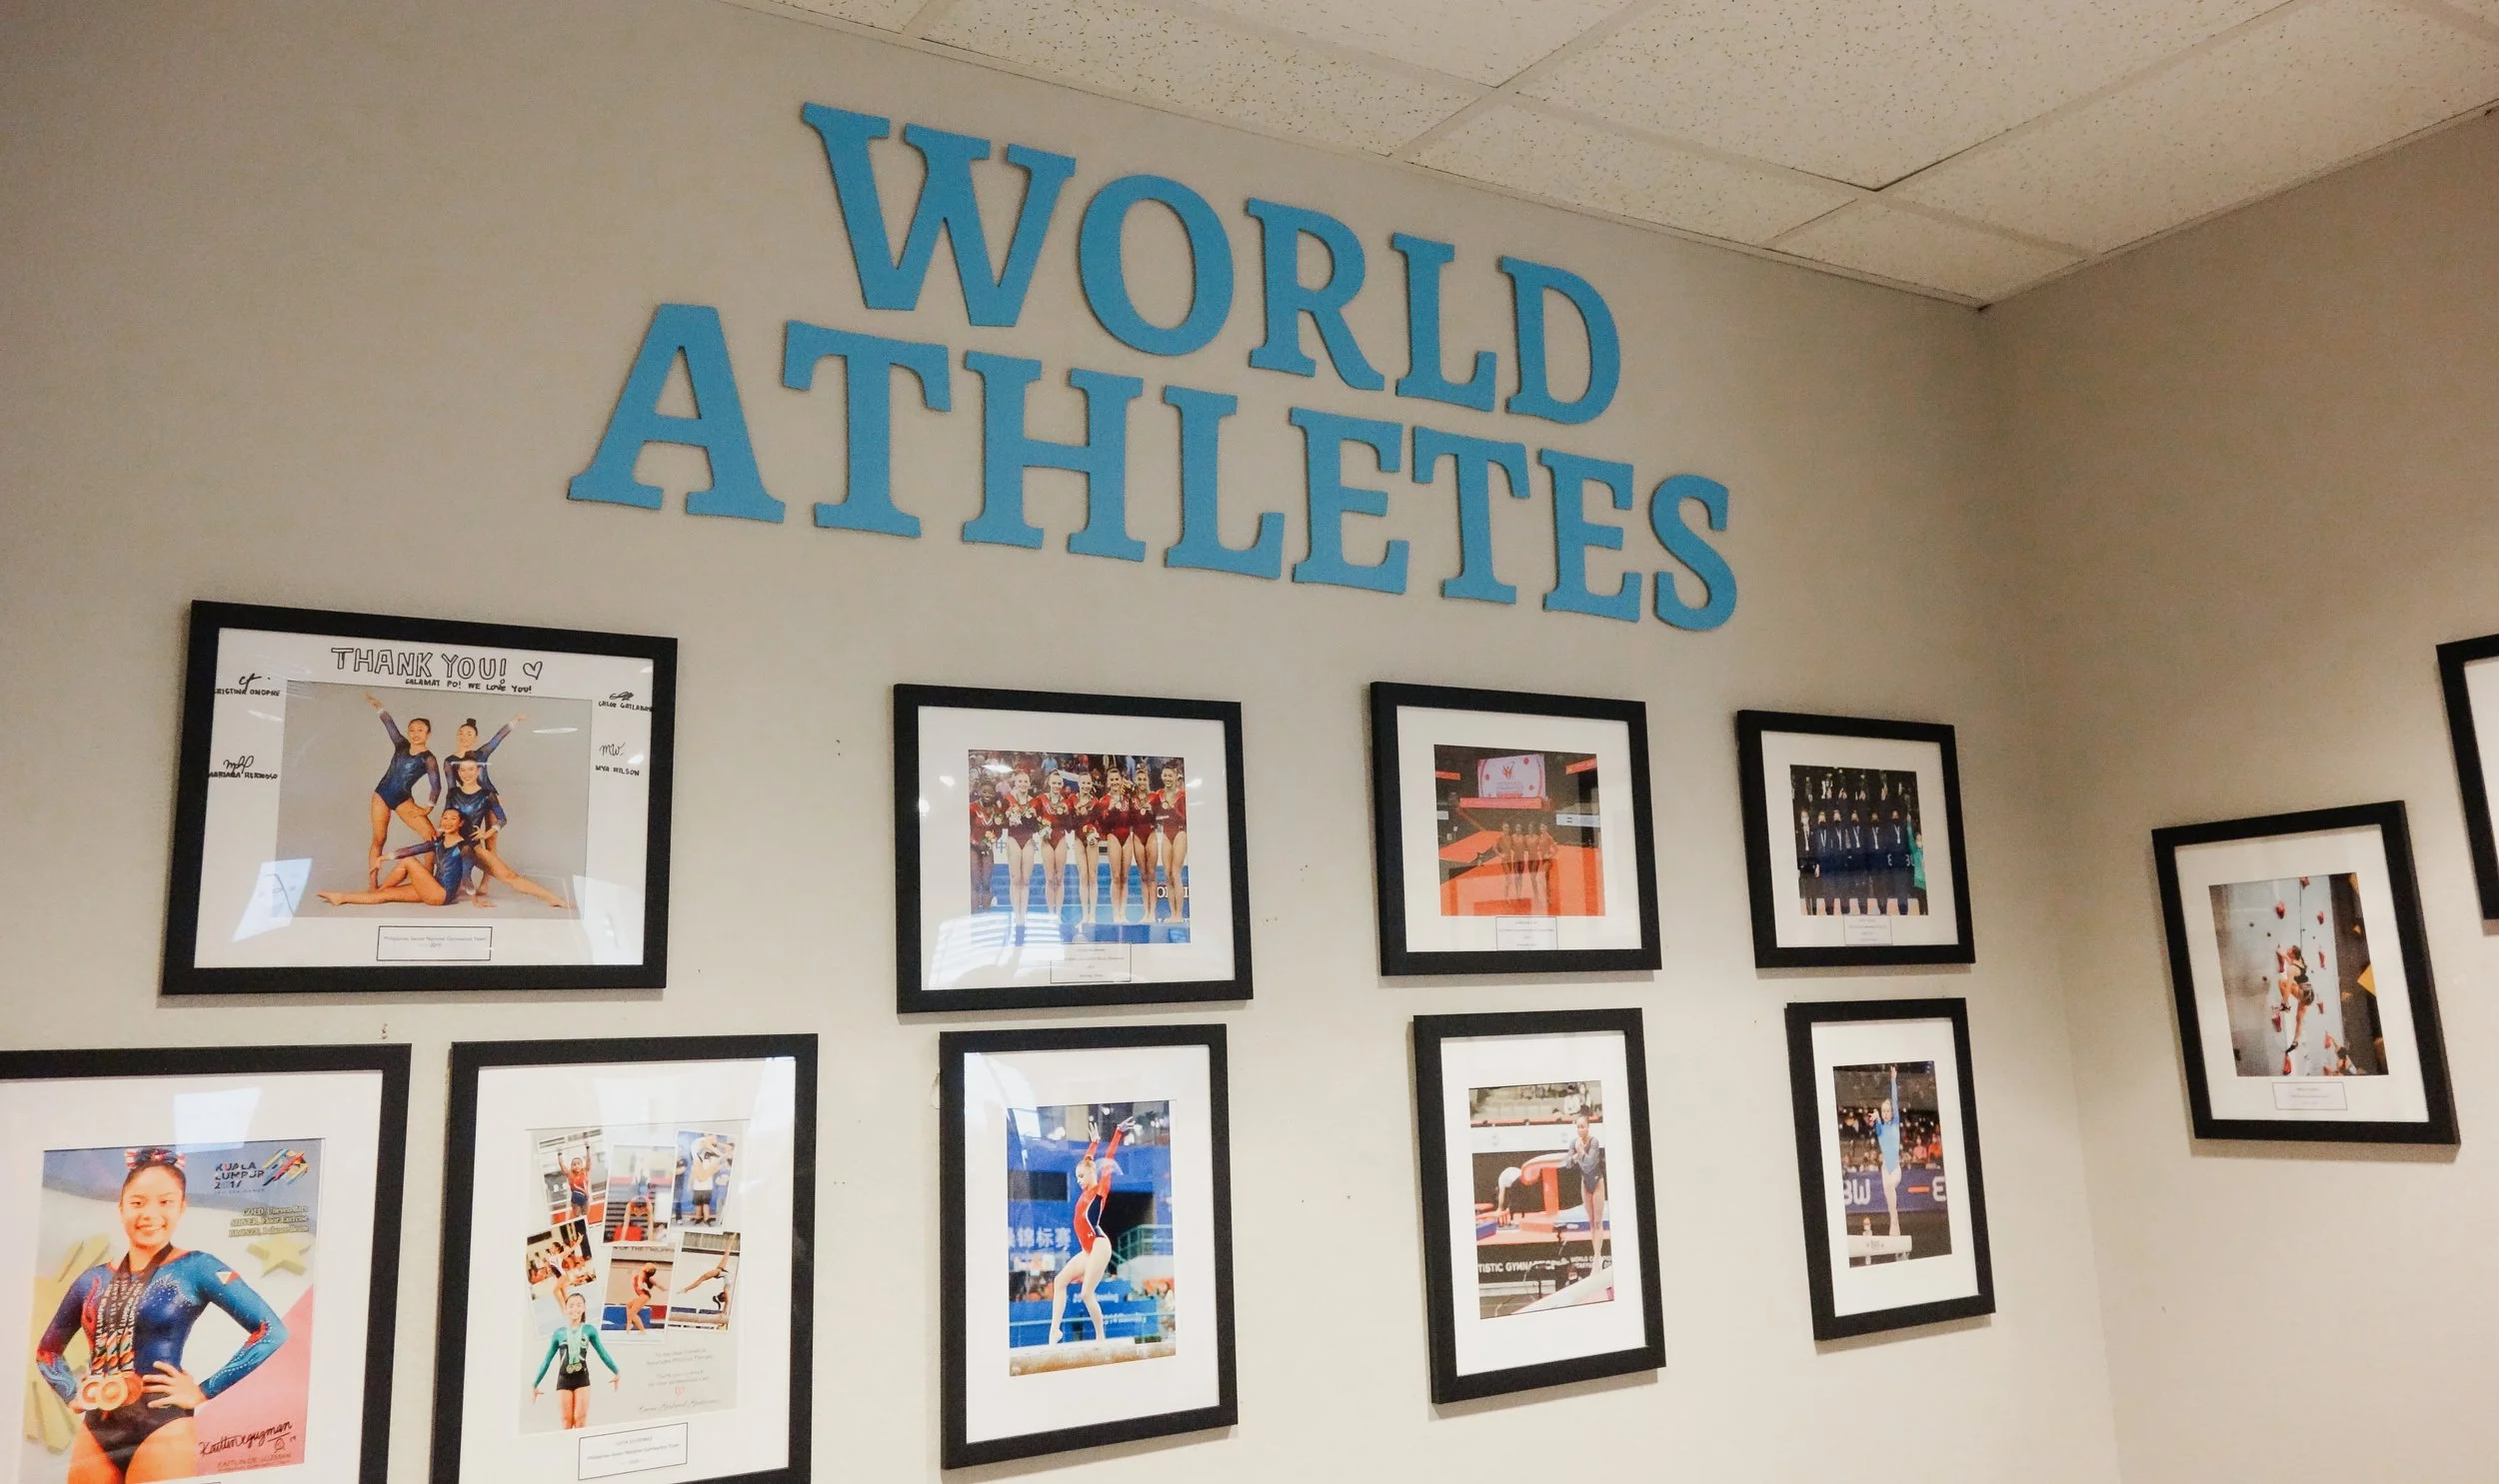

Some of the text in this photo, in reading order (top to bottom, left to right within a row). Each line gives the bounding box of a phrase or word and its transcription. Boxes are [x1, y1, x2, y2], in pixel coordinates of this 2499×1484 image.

[802, 101, 1620, 425] WORLD
[567, 302, 1737, 632] ATHLETES
[331, 648, 507, 685] THANK YOU!
[447, 680, 462, 689] PO!
[512, 685, 532, 694] YOU!
[215, 1161, 257, 1172] KUALA
